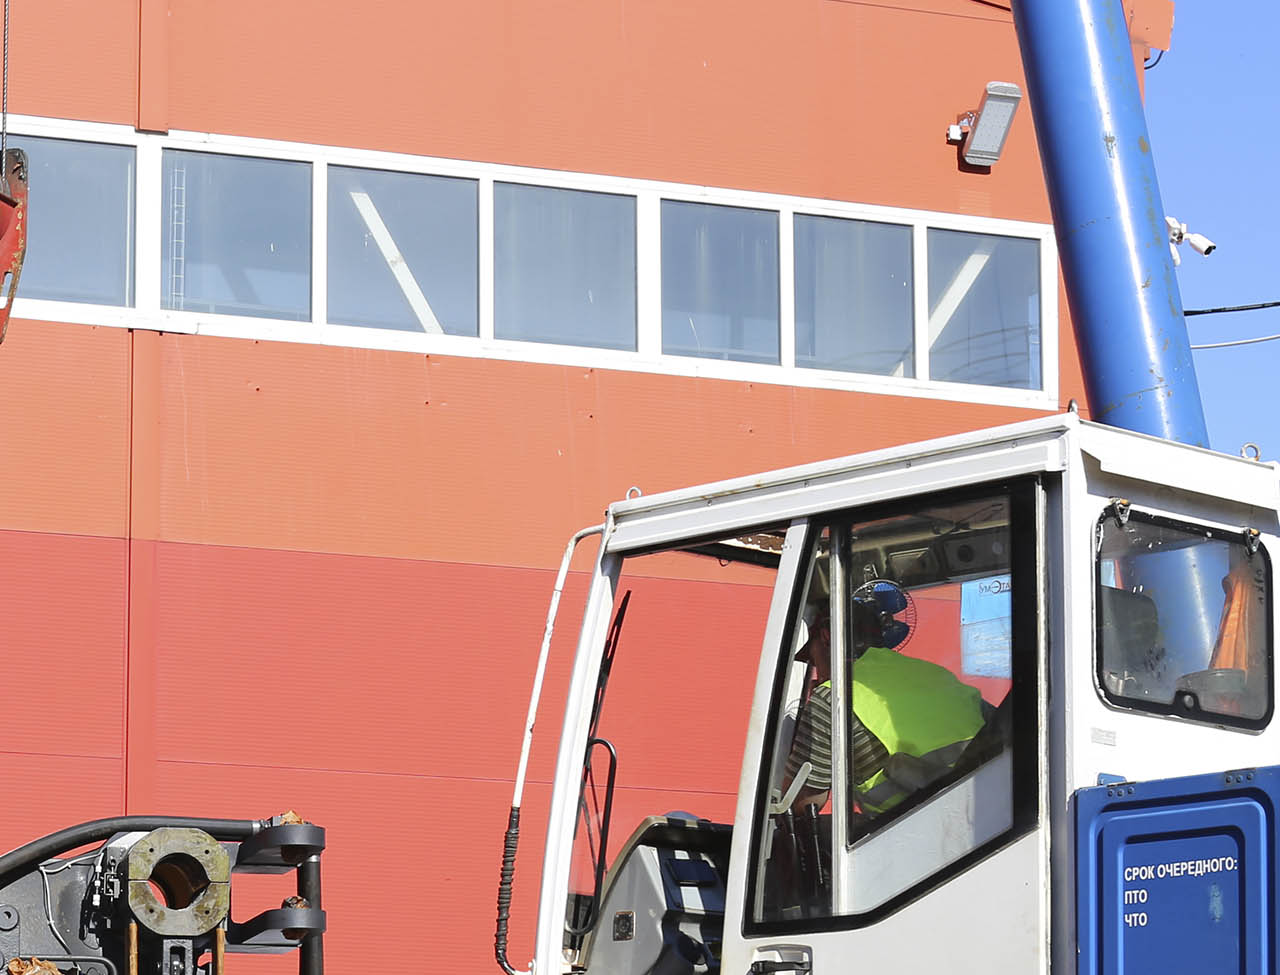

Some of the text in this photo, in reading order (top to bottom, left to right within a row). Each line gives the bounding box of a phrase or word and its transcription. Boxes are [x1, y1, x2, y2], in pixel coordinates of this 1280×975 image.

[1124, 856, 1238, 882] СРОК ОЧЕРЕДНОГО:
[1124, 889, 1148, 904] ПТО
[1124, 912, 1148, 928] ЧТО
